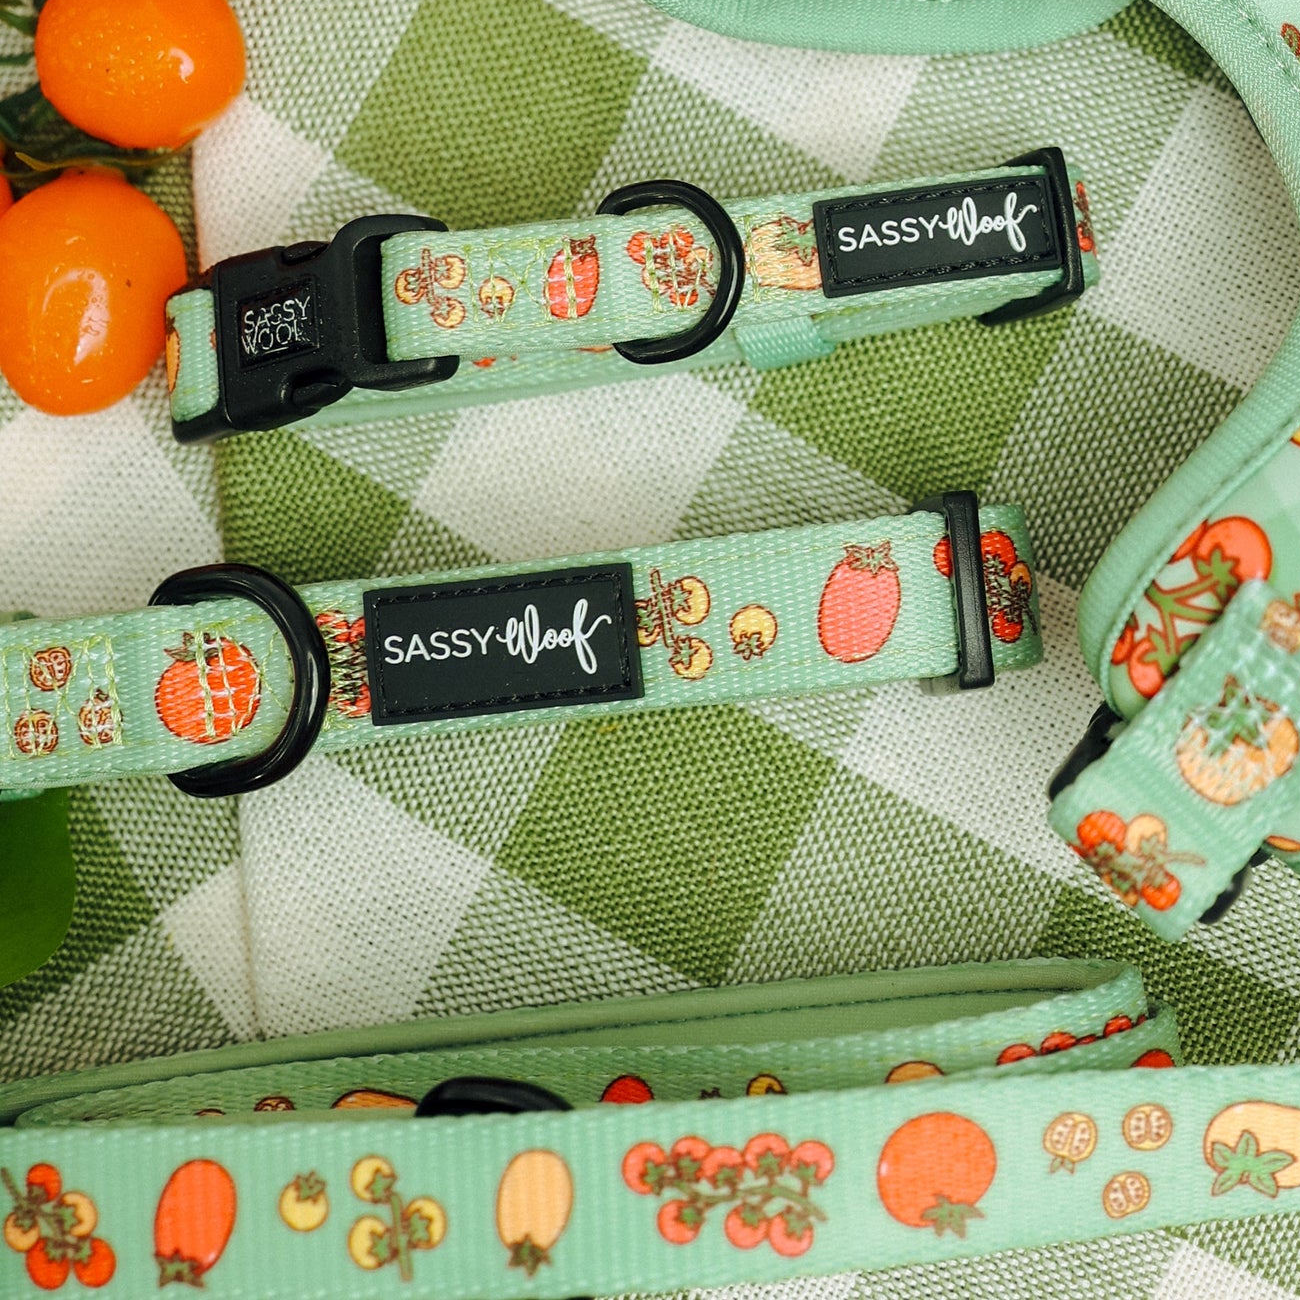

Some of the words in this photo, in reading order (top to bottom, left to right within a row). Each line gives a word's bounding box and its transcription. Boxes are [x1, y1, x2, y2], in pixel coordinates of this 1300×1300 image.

[838, 214, 940, 252] SASSY
[938, 192, 1038, 253] Woof
[244, 296, 310, 334] SASSY
[384, 625, 495, 664] SASSY
[496, 598, 612, 675] Woof
